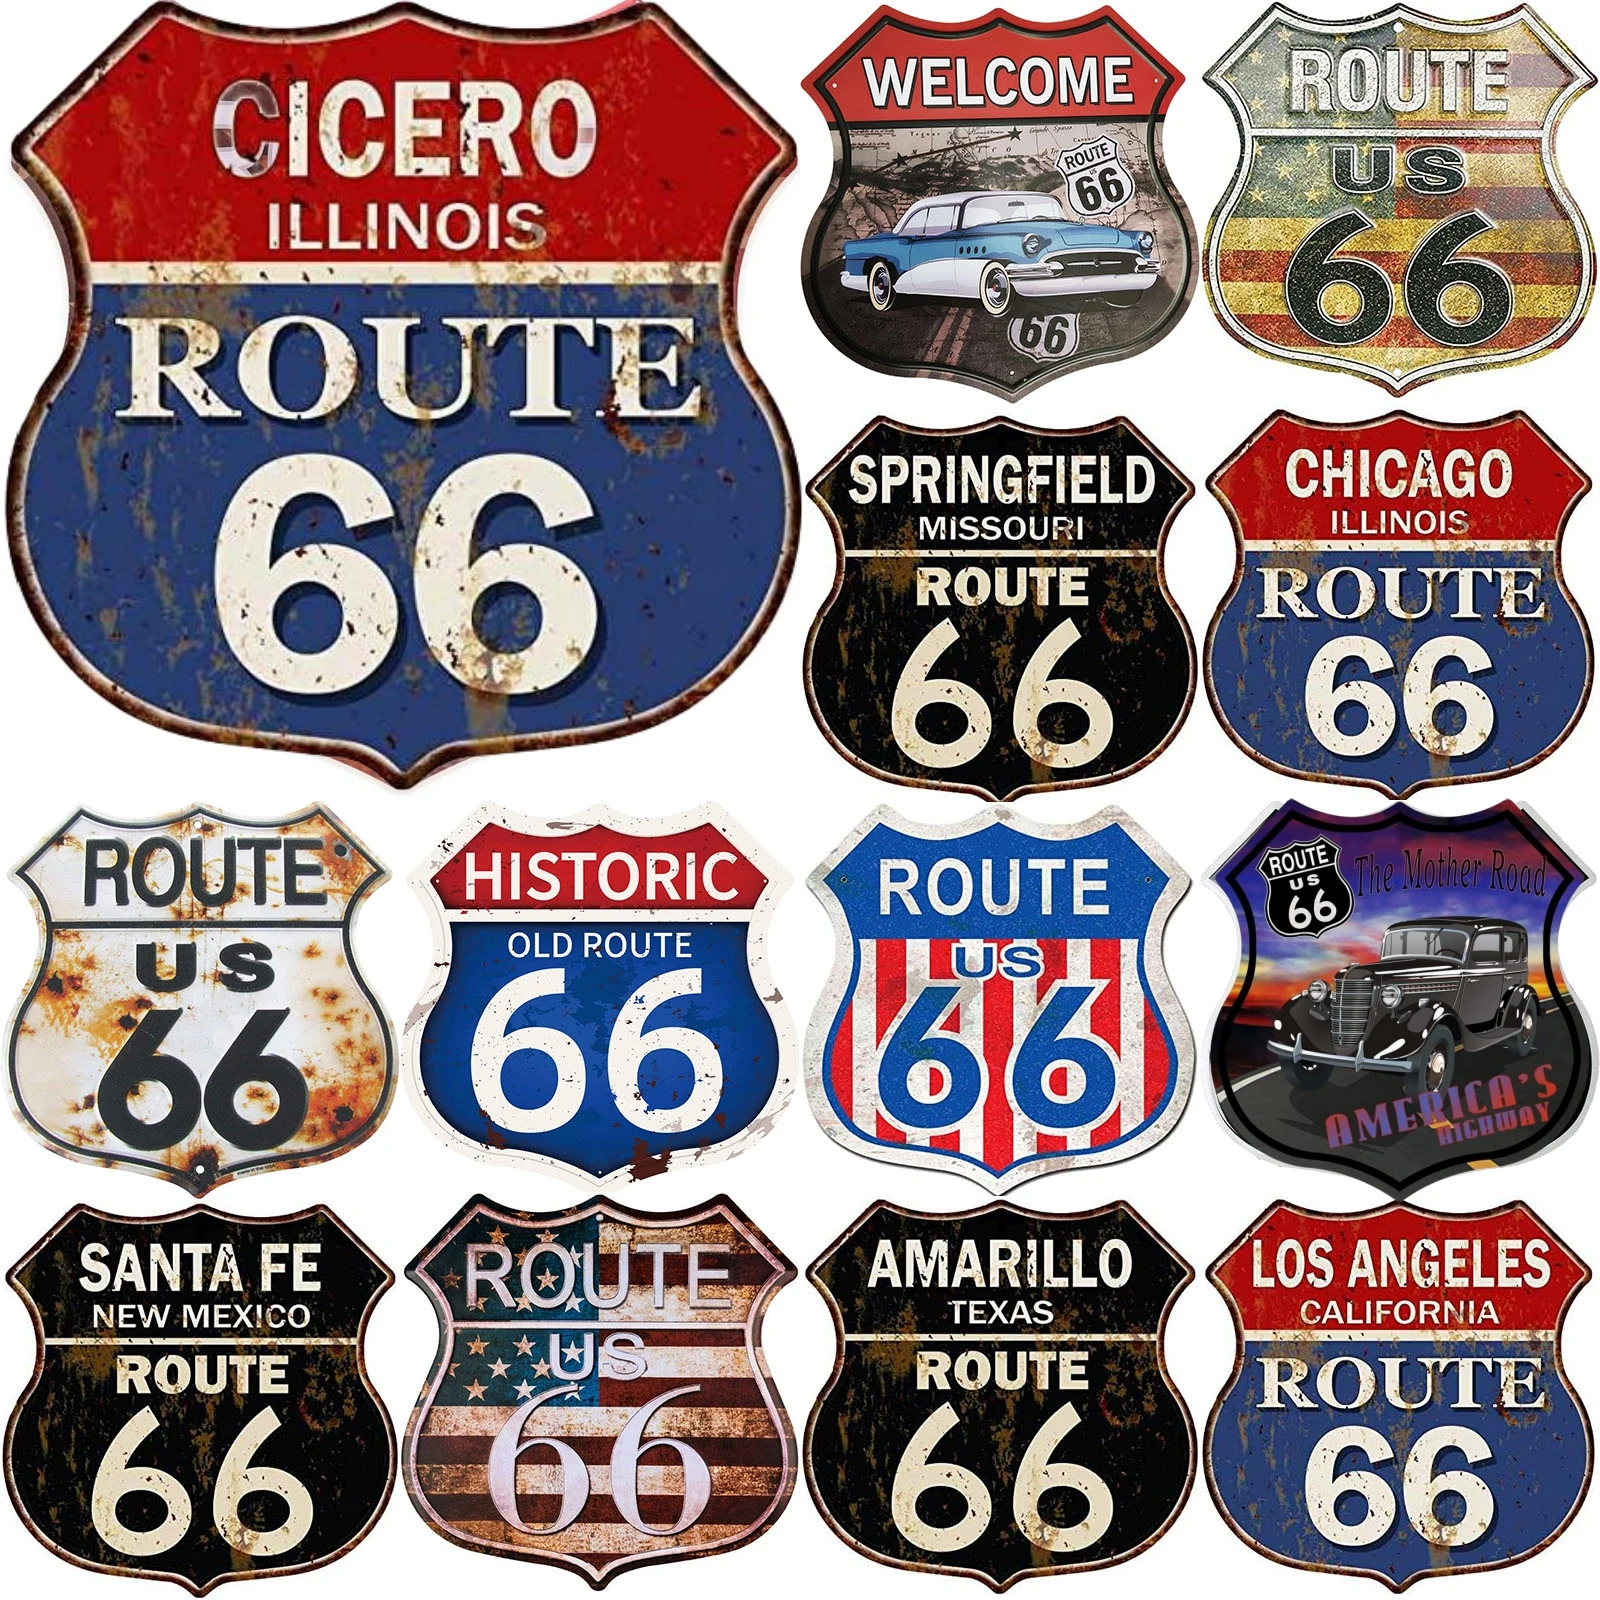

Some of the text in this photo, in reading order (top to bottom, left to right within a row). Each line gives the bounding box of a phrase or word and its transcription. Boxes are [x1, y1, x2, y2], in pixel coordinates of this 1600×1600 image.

[862, 55, 1134, 109] WELCOME
[1291, 47, 1509, 114] ROUTE
[212, 79, 597, 178] CICERO
[1064, 142, 1111, 171] ROUTE
[1333, 145, 1467, 195] US
[1075, 167, 1125, 211] 66
[267, 201, 549, 252] ILLINOIS
[1285, 209, 1514, 347] 66
[1019, 313, 1069, 354] 66
[114, 314, 702, 422] ROUTE
[849, 455, 1155, 504] SPRINGFIELD
[1285, 448, 1513, 498] CHICAGO
[919, 516, 1083, 540] MISSOURI
[1331, 509, 1469, 535] ILLINOIS
[214, 452, 599, 695] 66
[916, 567, 1089, 606] ROUTE
[1256, 566, 1546, 619] ROUTE
[891, 617, 1114, 769] 66
[1305, 635, 1495, 756] 66
[84, 836, 328, 907] ROUTE
[465, 852, 739, 901] HISTORIC
[1269, 844, 1329, 875] ROUTE
[1289, 874, 1320, 891] US
[1354, 847, 1547, 897] The Mother Road
[879, 858, 1110, 916] ROUTE
[1288, 889, 1337, 929] 66
[136, 942, 275, 992] US
[508, 931, 692, 958] OLD ROUTE
[954, 945, 1043, 978] US
[470, 968, 723, 1134] 66
[877, 986, 1116, 1129] 66
[98, 1007, 310, 1151] 66
[1325, 1064, 1557, 1148] AMERICA'S
[1437, 1102, 1550, 1146] HIGHWAY
[79, 1242, 321, 1292] SANTA FE
[466, 1242, 732, 1310] ROUTE
[868, 1238, 1133, 1289] AMARILLO
[1252, 1238, 1550, 1289] LOS ANGELES
[93, 1304, 310, 1329] NEW MEXICO
[949, 1300, 1054, 1325] TEXAS
[1300, 1300, 1500, 1325] CALIFORNIA
[116, 1354, 289, 1395] ROUTE
[550, 1331, 647, 1381] US
[916, 1351, 1089, 1390] ROUTE
[1256, 1356, 1546, 1410] ROUTE
[91, 1405, 314, 1557] 66
[488, 1384, 712, 1535] 66
[891, 1401, 1114, 1553] 66
[1305, 1425, 1495, 1547] 66
